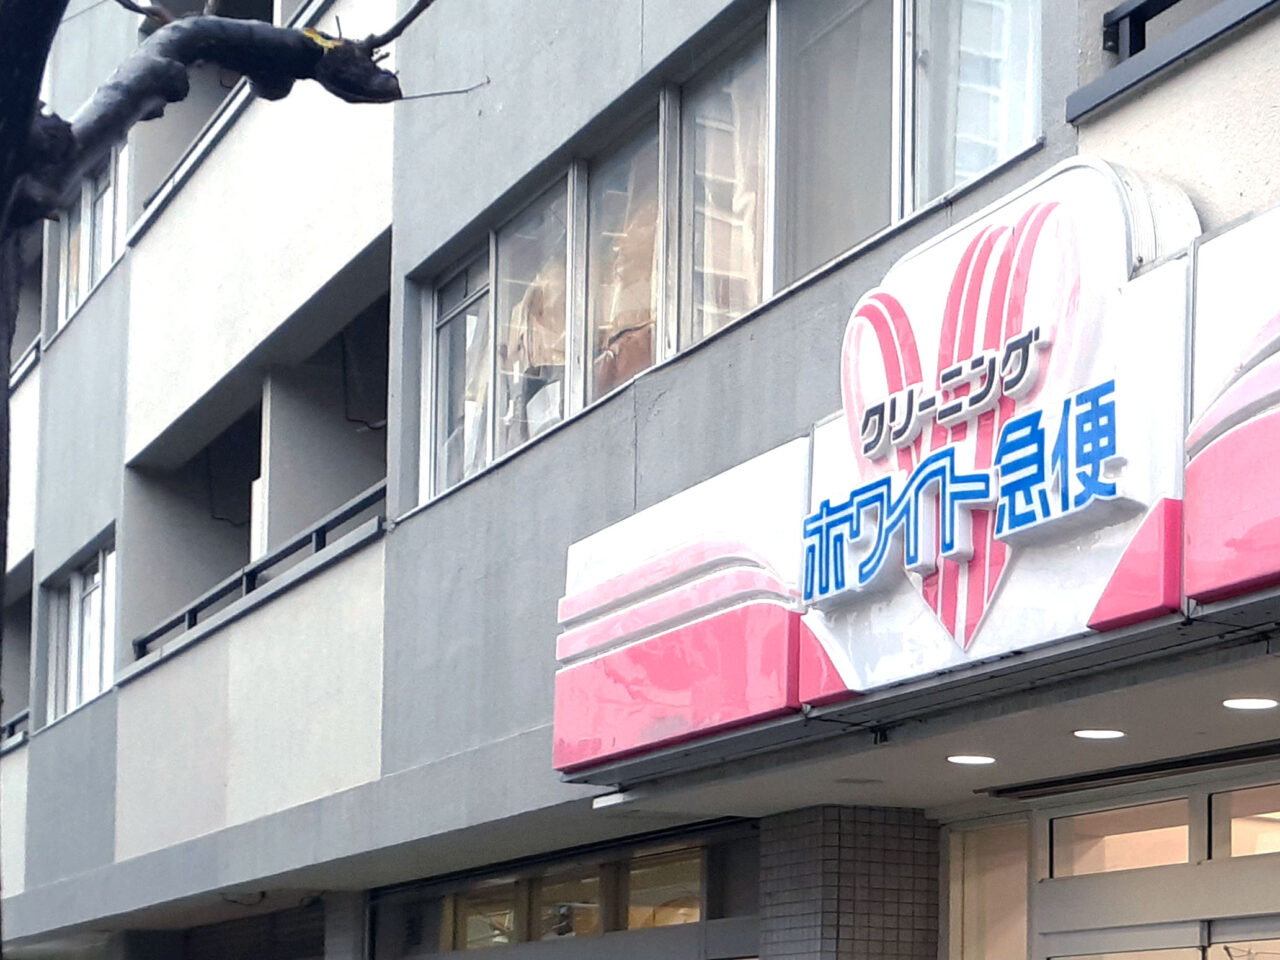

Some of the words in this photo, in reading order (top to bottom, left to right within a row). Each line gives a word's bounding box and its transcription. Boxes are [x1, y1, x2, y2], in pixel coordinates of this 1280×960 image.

[861, 327, 1040, 456] クリーニング
[803, 379, 1117, 601] ホワイト急便
